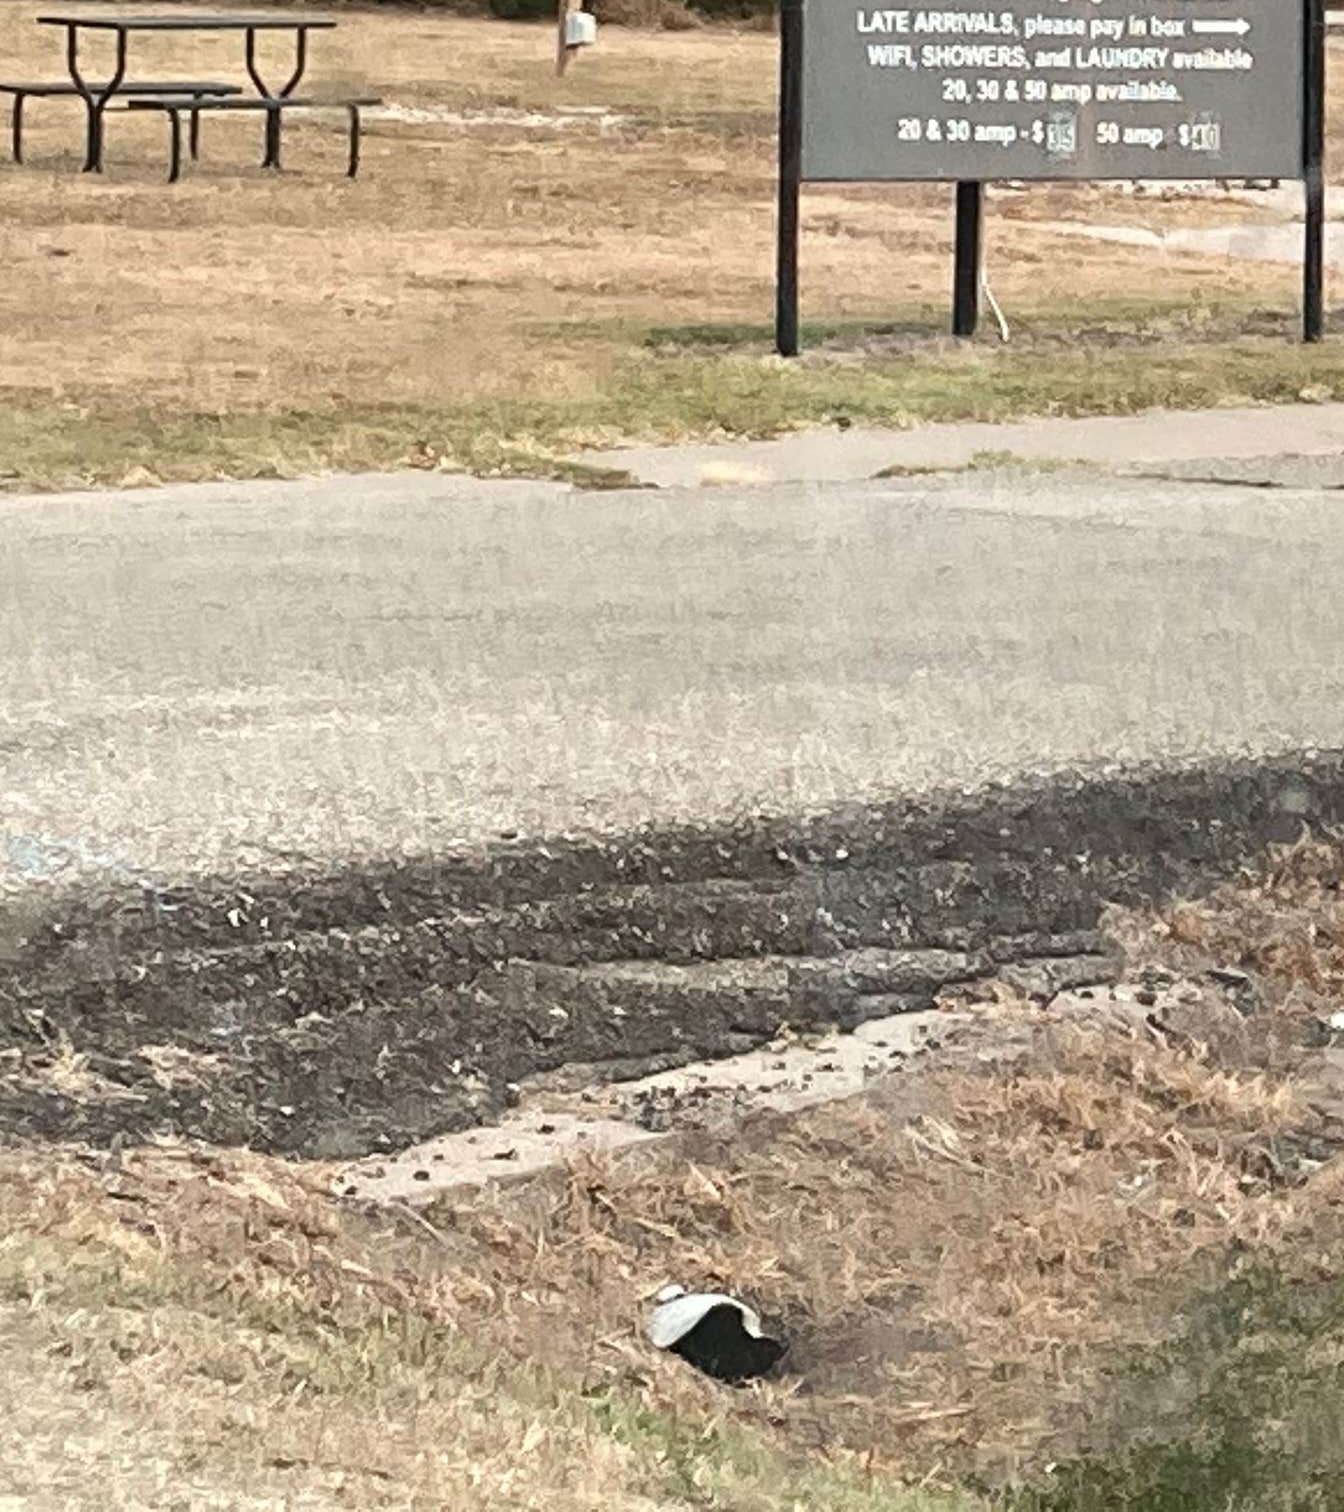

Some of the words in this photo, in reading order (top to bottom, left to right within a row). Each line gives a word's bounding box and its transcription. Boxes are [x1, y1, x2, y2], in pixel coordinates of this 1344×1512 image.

[857, 10, 910, 33] LATE
[914, 11, 1020, 37] ARRIVALS,
[1024, 14, 1086, 39] please
[1090, 18, 1124, 40] pay
[1128, 15, 1147, 36] in
[1151, 15, 1186, 36] box
[868, 44, 917, 70] WIFI,
[920, 44, 1031, 70] SHOWERS,
[1035, 47, 1072, 68] and
[1075, 46, 1169, 69] LAUNDRY
[1171, 46, 1254, 70] available
[942, 78, 972, 104] 20,
[976, 79, 1000, 101] 30
[1004, 79, 1020, 101] &
[1024, 80, 1047, 101] 50
[1050, 82, 1092, 106] amp
[897, 117, 922, 141] 20
[926, 118, 943, 141] &
[947, 119, 971, 142] 30
[974, 124, 1017, 148] amp
[1096, 121, 1120, 144] 50
[1122, 126, 1164, 150] amp
